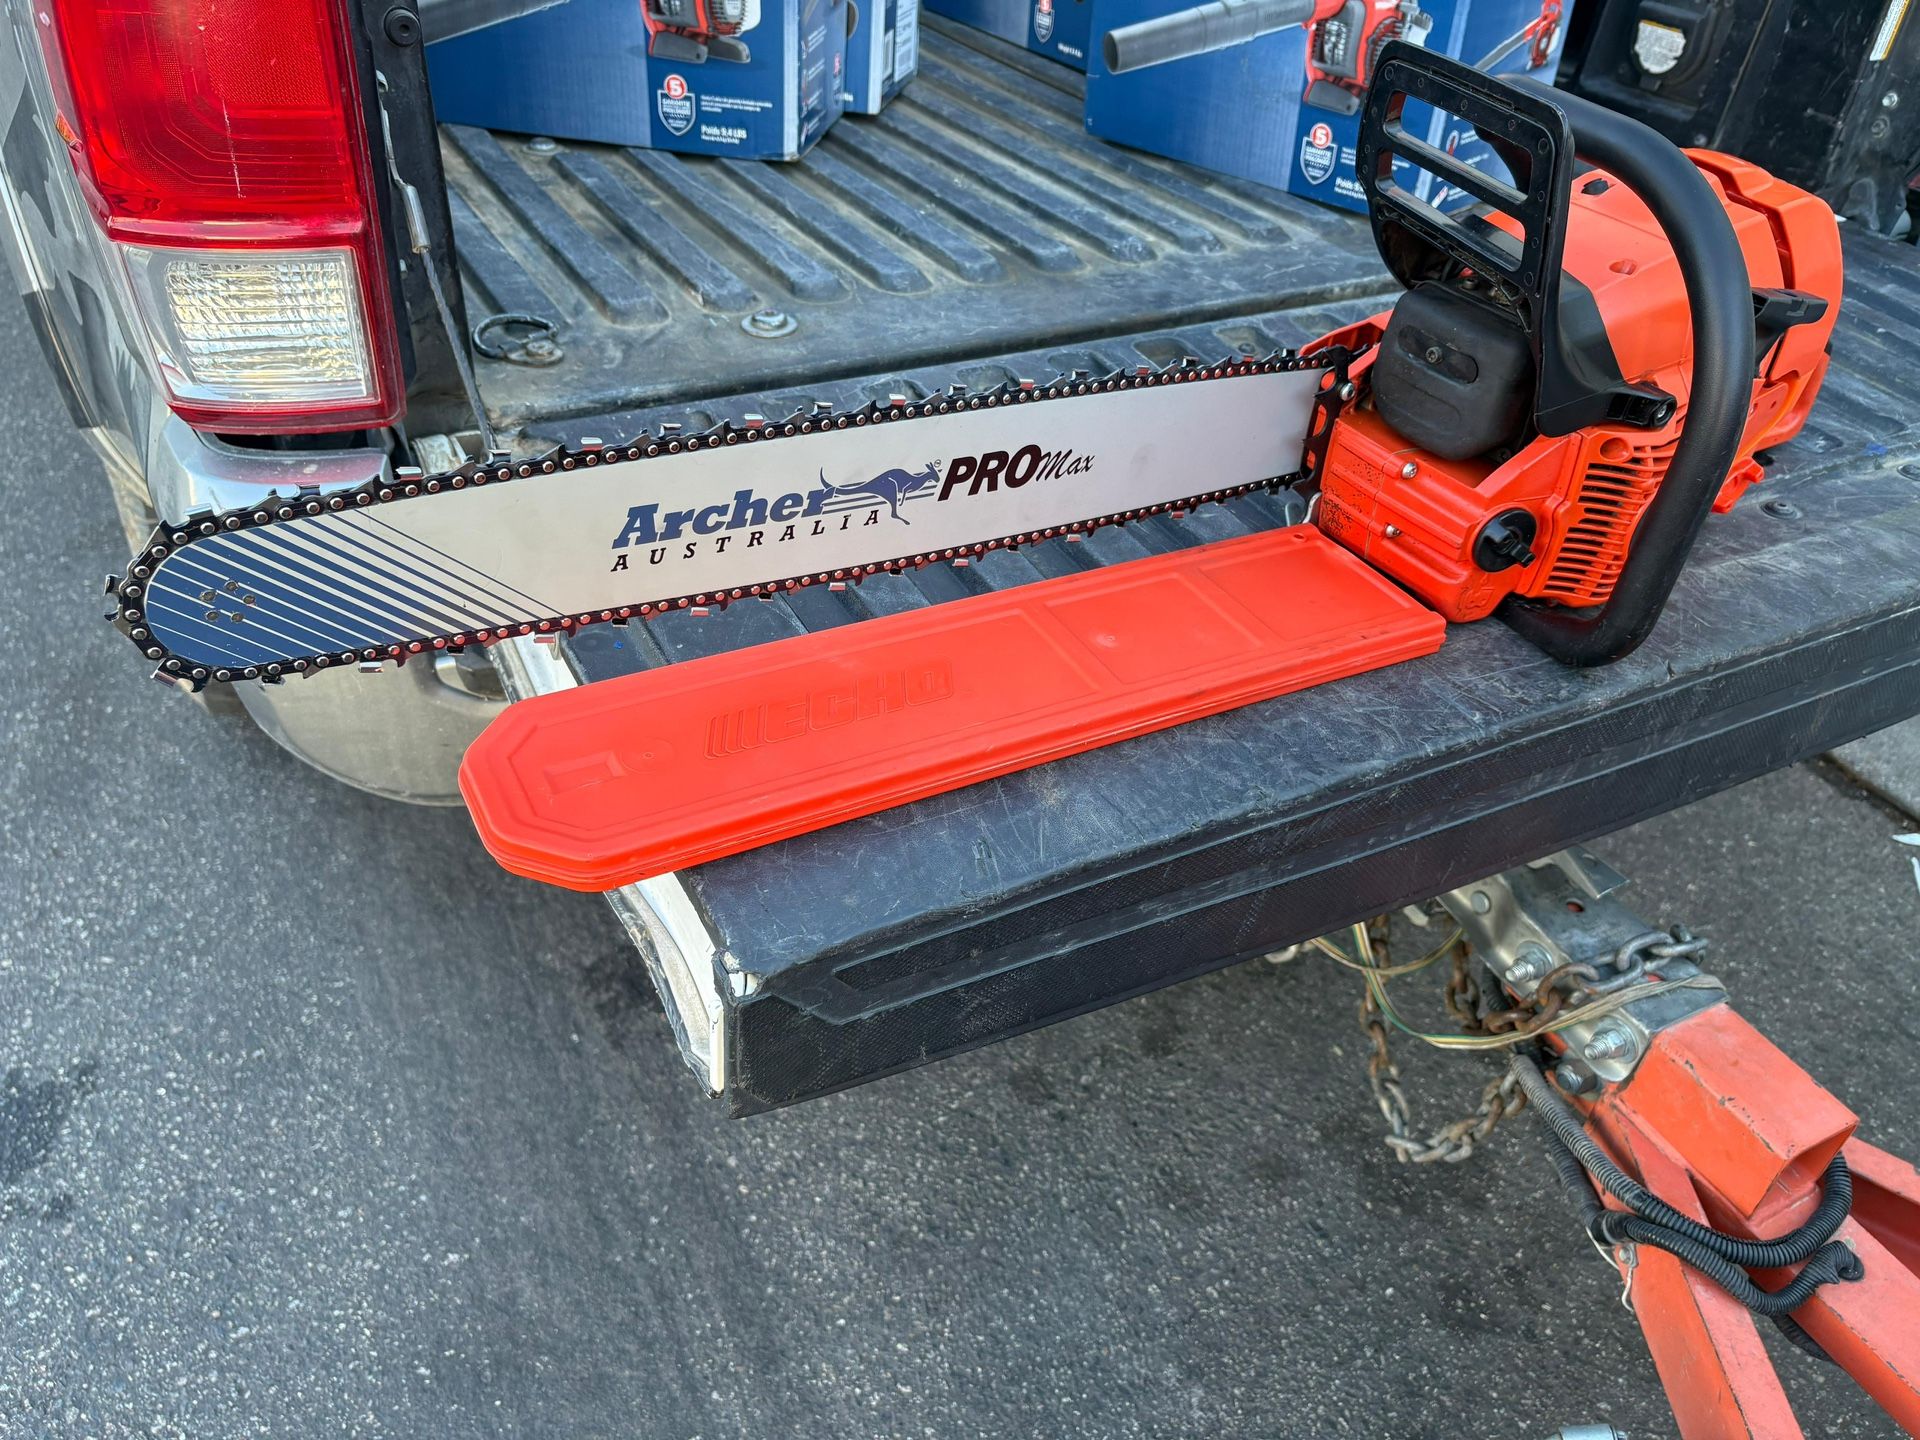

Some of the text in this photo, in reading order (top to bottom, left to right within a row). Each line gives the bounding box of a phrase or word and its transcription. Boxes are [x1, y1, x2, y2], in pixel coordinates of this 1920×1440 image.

[669, 79, 683, 96] 5
[1315, 127, 1328, 145] 5
[938, 443, 1096, 502] PRO Max
[610, 508, 881, 573] AUSTRALIA
[611, 487, 834, 549] Archer
[763, 657, 955, 744] ECHO
